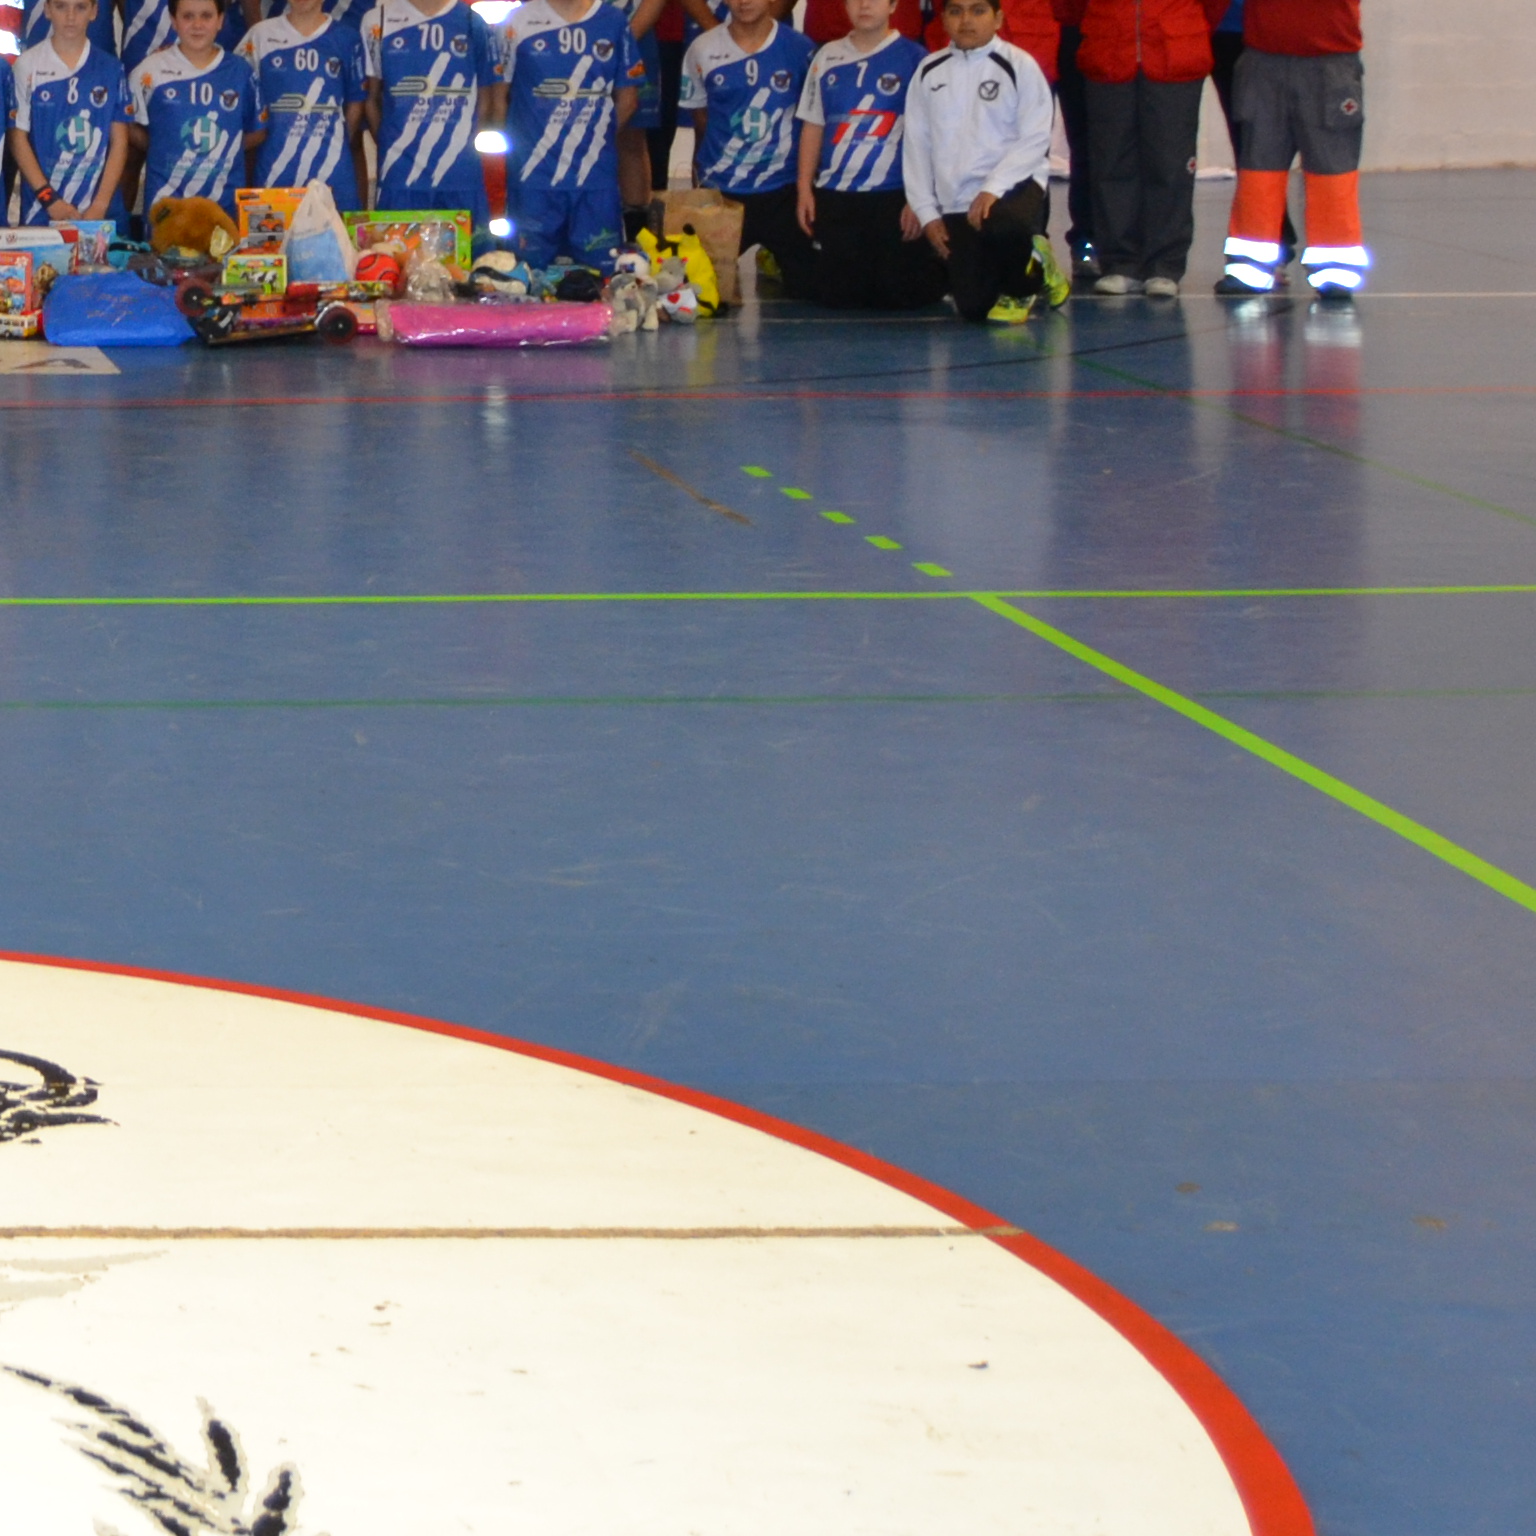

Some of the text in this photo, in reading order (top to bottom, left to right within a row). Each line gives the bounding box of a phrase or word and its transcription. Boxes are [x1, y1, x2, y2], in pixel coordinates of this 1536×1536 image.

[419, 23, 445, 52] 70
[558, 26, 586, 55] 90
[294, 48, 319, 73] 60
[745, 61, 759, 86] 9
[856, 62, 868, 88] 7
[66, 82, 80, 106] 8
[188, 81, 214, 106] 10
